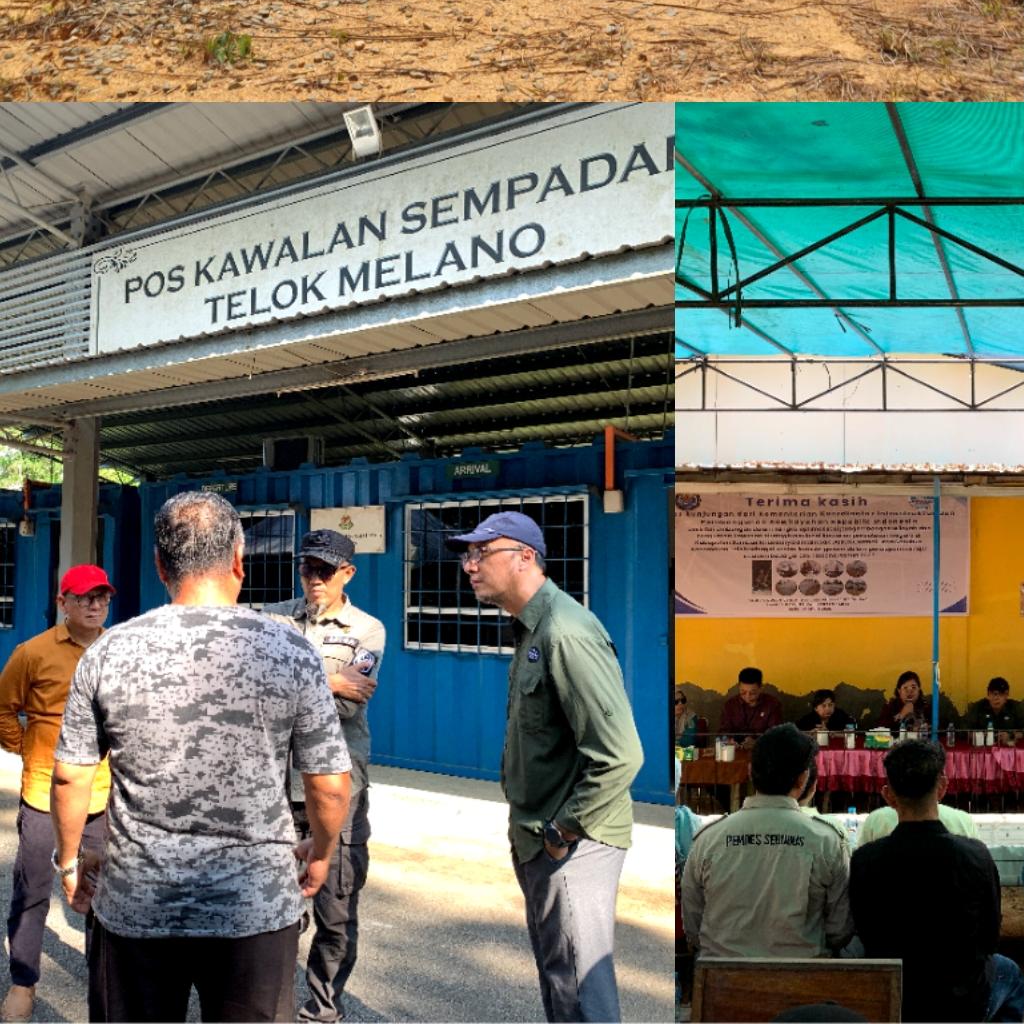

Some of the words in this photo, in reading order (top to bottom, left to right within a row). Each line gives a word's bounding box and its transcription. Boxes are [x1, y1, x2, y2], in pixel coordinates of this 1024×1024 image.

[123, 263, 185, 304] POS
[194, 210, 388, 287] KAWALAN
[204, 270, 327, 324] TELOK
[338, 221, 546, 297] MELANO
[454, 463, 492, 476] ARRIVAL
[745, 496, 811, 507] Terima
[817, 496, 868, 507] kasih
